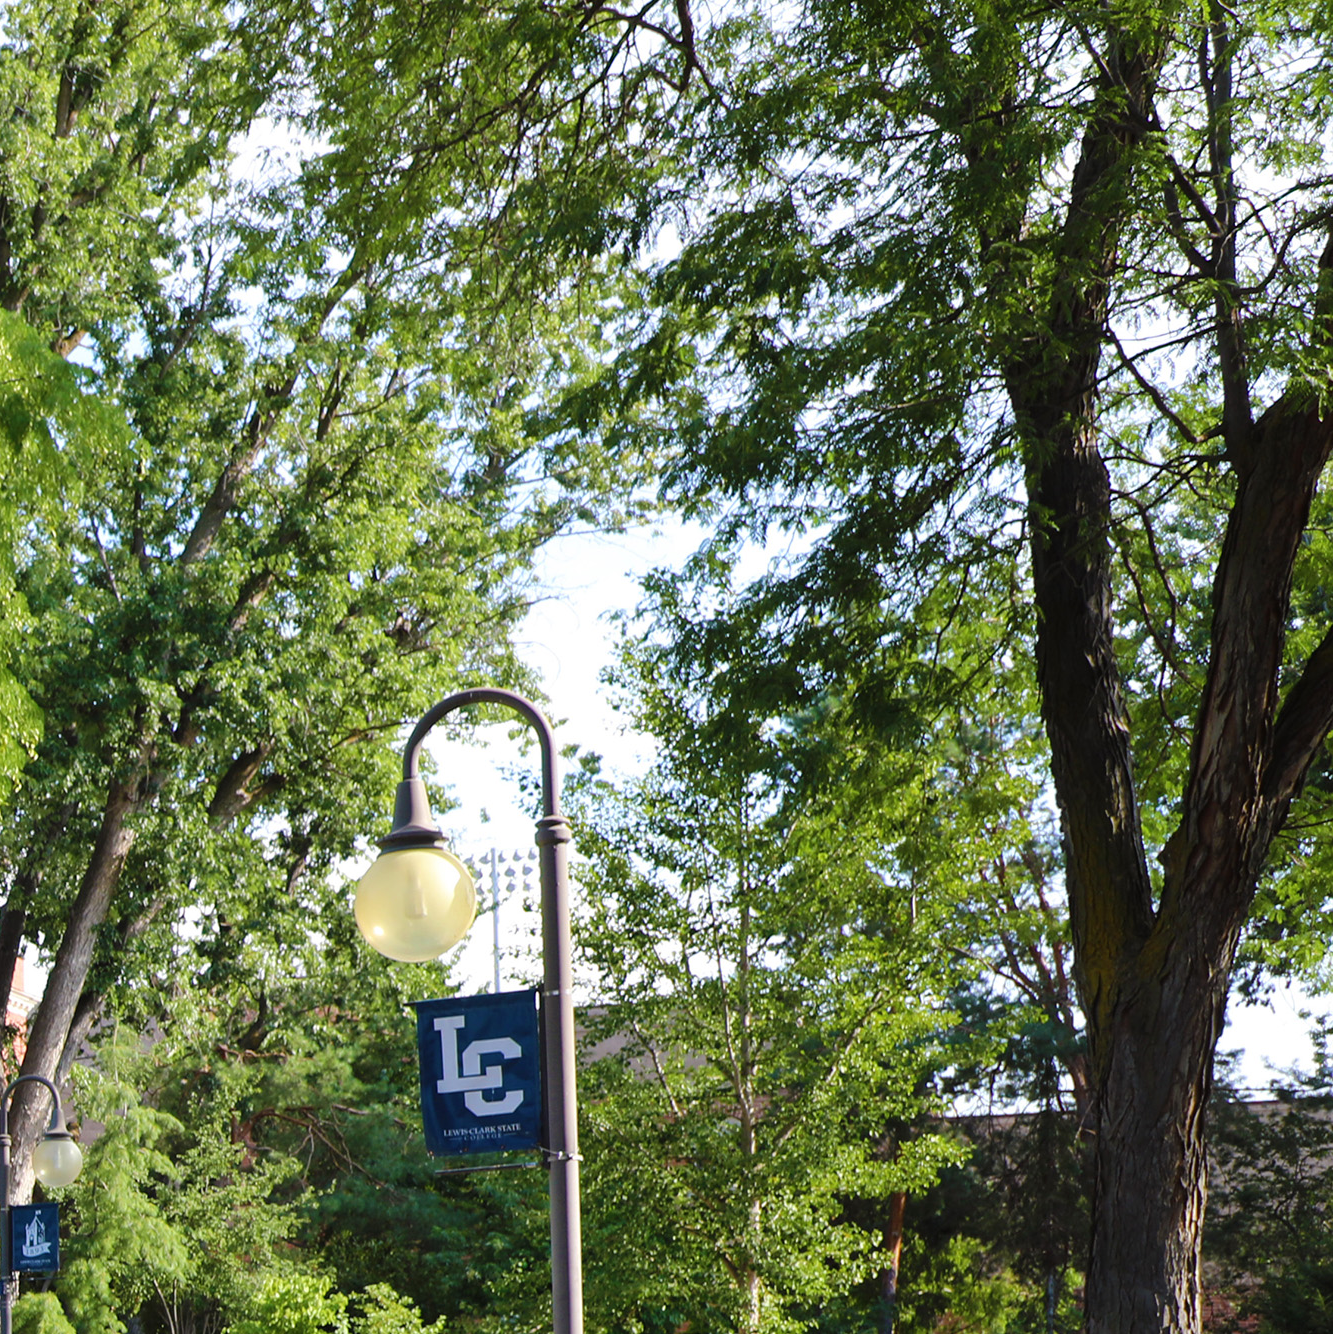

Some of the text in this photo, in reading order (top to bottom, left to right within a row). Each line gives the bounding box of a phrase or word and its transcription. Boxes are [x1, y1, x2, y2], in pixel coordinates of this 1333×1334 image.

[434, 1015, 524, 1117] LC
[443, 1122, 521, 1137] LEWIS CLARK STATE
